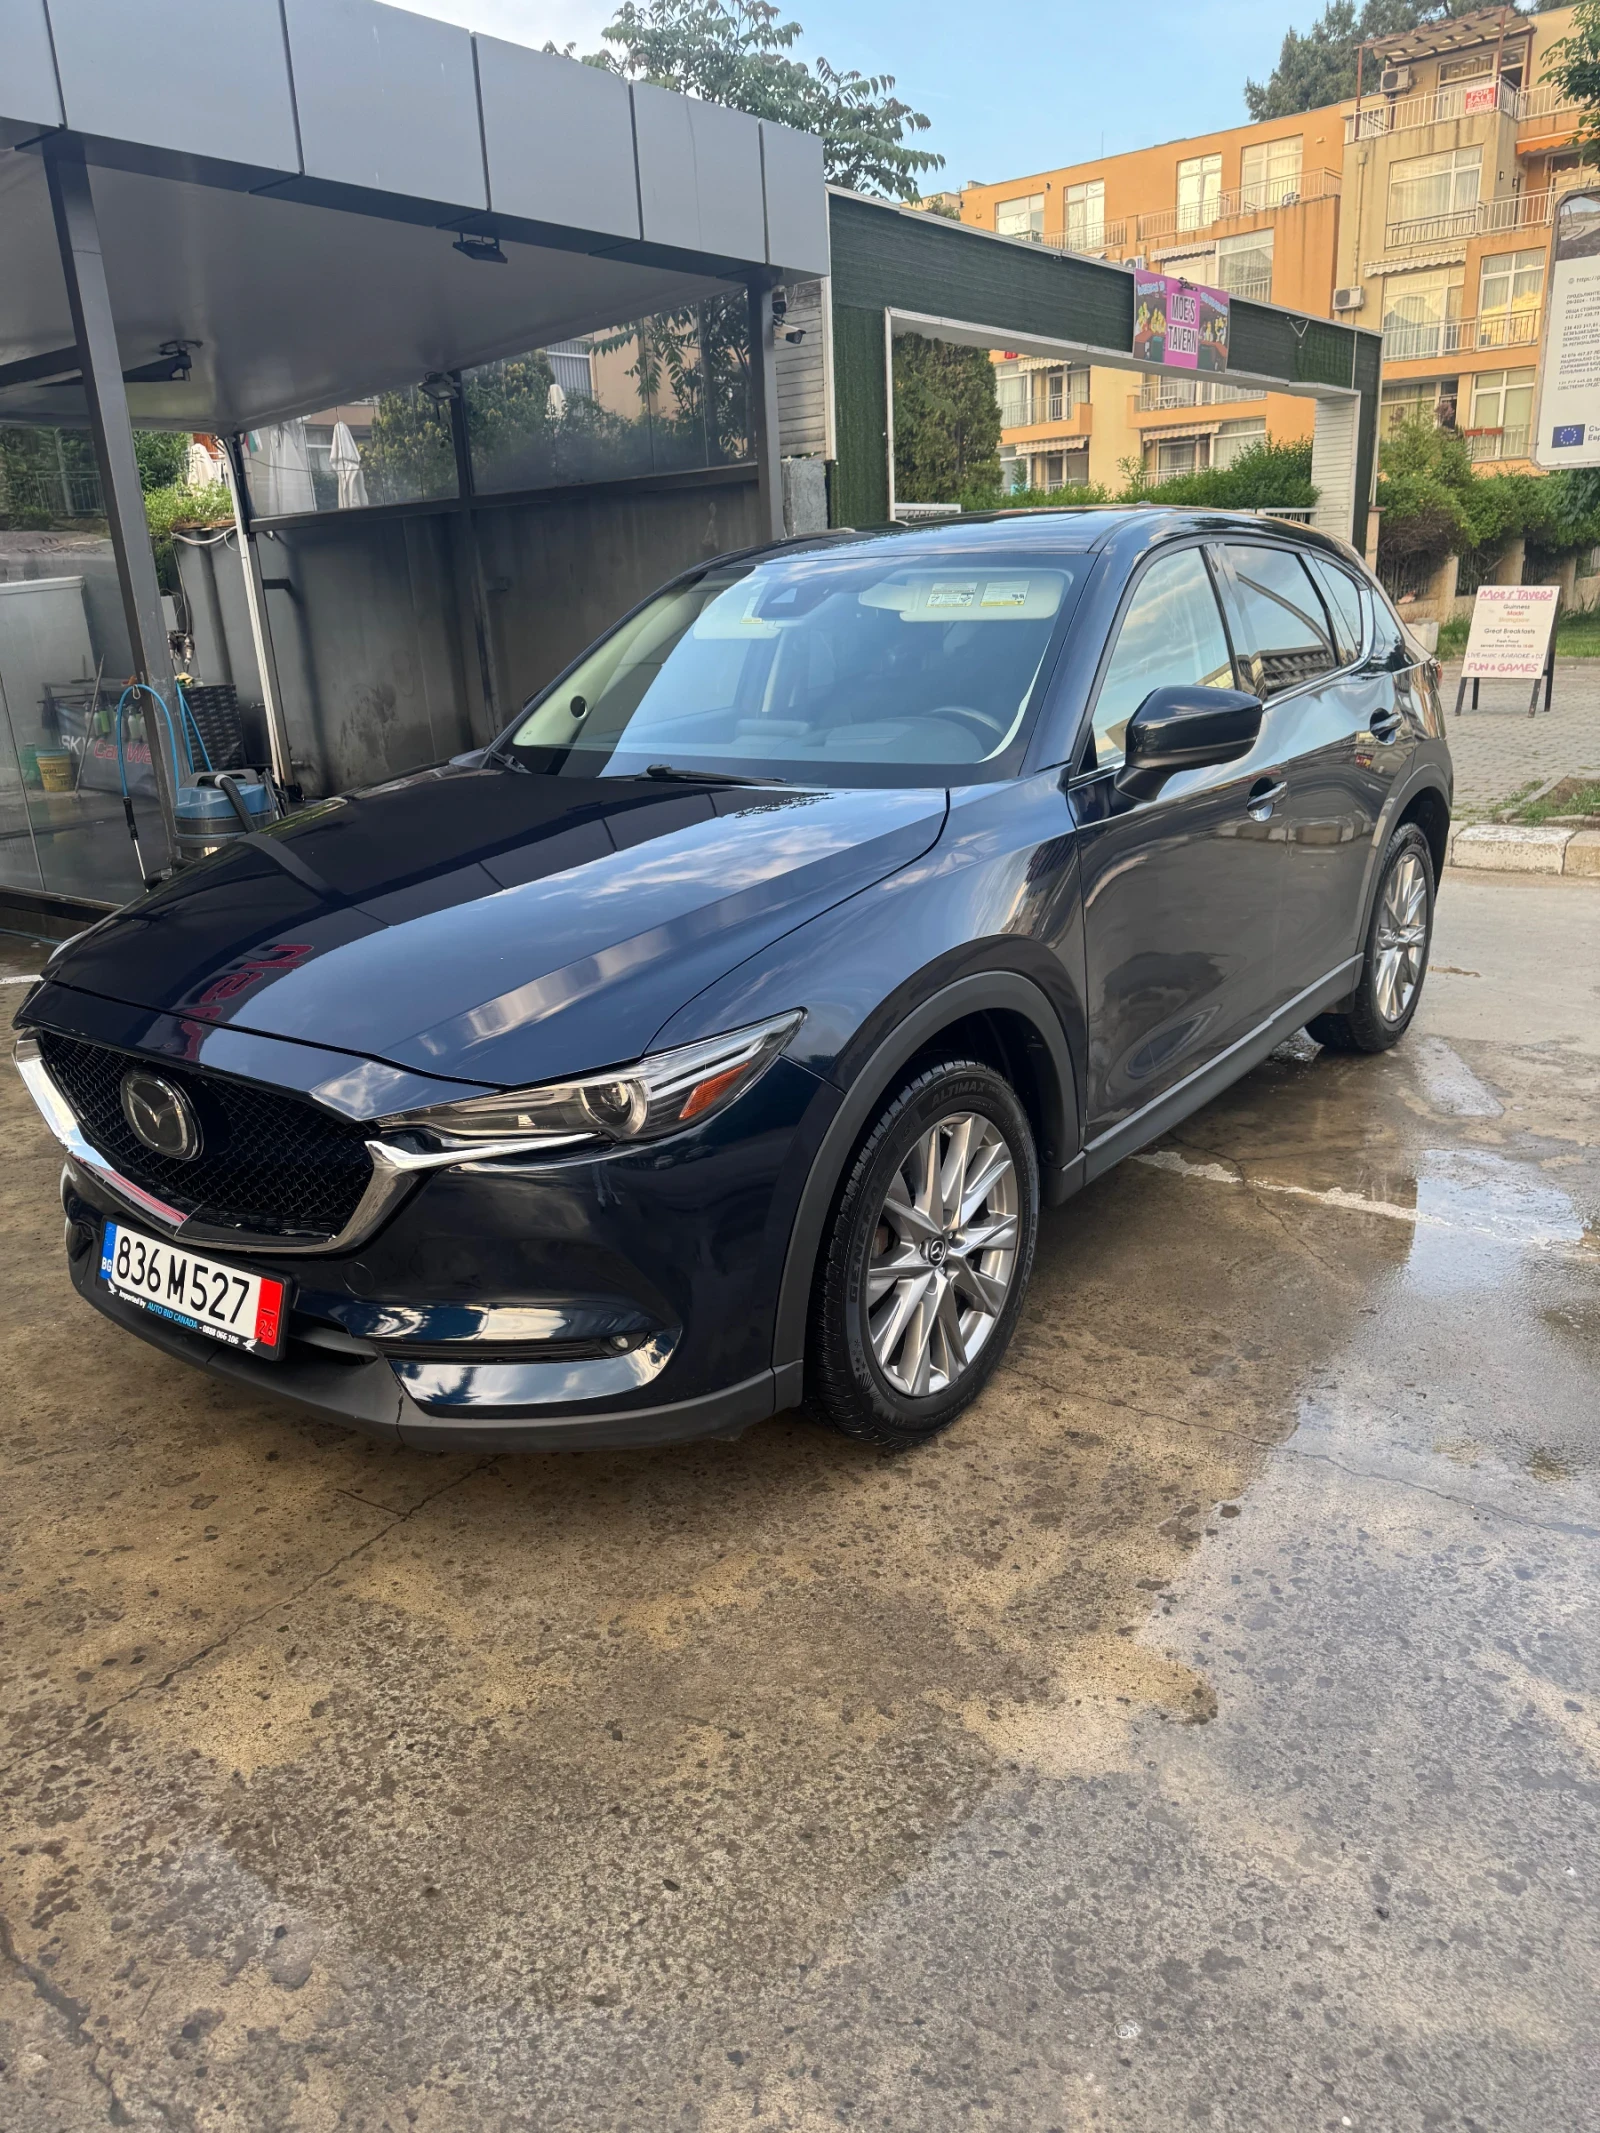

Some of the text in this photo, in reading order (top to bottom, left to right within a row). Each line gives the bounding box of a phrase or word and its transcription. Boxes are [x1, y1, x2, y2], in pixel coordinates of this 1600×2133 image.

[1467, 94, 1493, 105] SALE
[1470, 89, 1490, 99] FOR
[1172, 294, 1196, 324] MOE'S
[1168, 325, 1198, 354] TAVERN
[1468, 662, 1489, 672] FUN
[1497, 663, 1539, 673] GAMES
[932, 1081, 986, 1109] ALTIMAX
[101, 1256, 113, 1272] BG
[116, 1235, 250, 1324] 836 M 527
[119, 1290, 140, 1305] Imported
[139, 1298, 147, 1308] by
[147, 1302, 162, 1315] AUTO
[163, 1308, 173, 1319] BID
[173, 1313, 198, 1330] CANADA
[258, 1320, 274, 1339] 26
